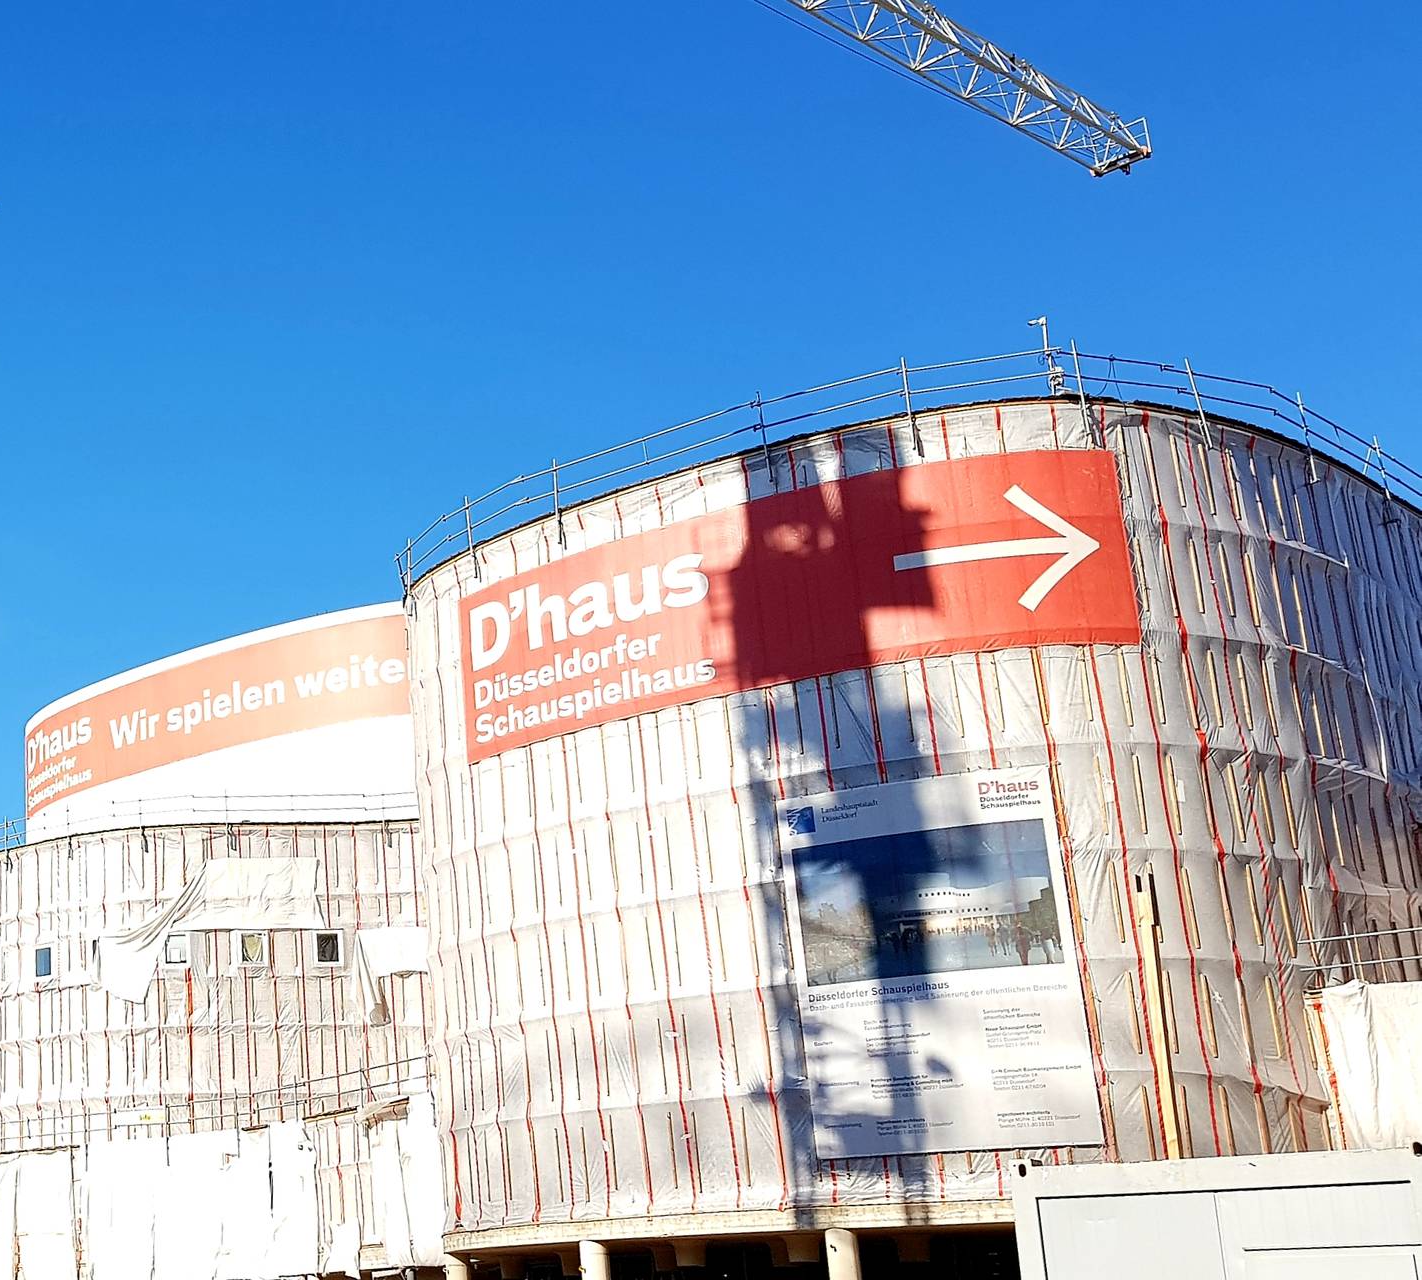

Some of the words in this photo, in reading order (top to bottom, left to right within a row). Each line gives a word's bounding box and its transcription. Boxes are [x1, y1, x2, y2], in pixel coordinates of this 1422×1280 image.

[473, 633, 662, 710] Düsseldorfer
[109, 709, 160, 751] Wir
[166, 677, 285, 735] spielen
[294, 654, 410, 700] weite
[474, 657, 716, 744] Schauspielhaus
[979, 793, 1030, 804] Düsseldorfer
[980, 799, 1041, 811] Schauspielhaus
[808, 989, 869, 1003] Düsseldorfer
[871, 981, 950, 997] Schauspielhaus
[930, 990, 970, 1001] Sanierung
[970, 989, 984, 997] der
